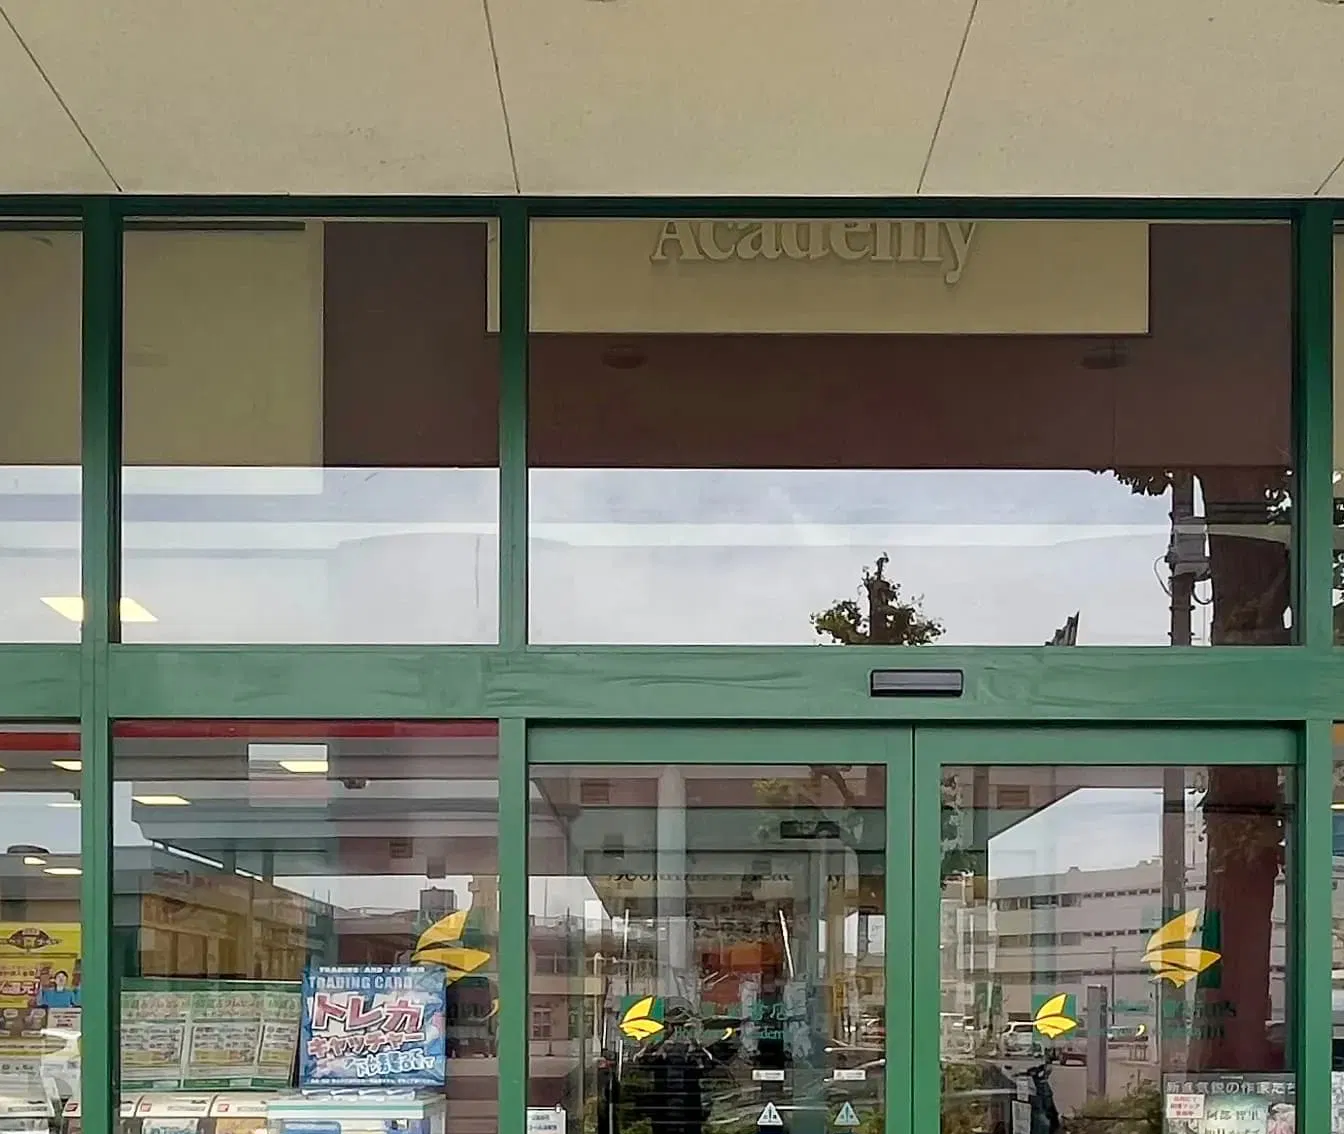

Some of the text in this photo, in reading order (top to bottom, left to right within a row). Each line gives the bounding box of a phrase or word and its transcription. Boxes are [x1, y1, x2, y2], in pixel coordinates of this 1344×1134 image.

[309, 976, 413, 989] TRADING CARD
[312, 991, 424, 1032] トレカ
